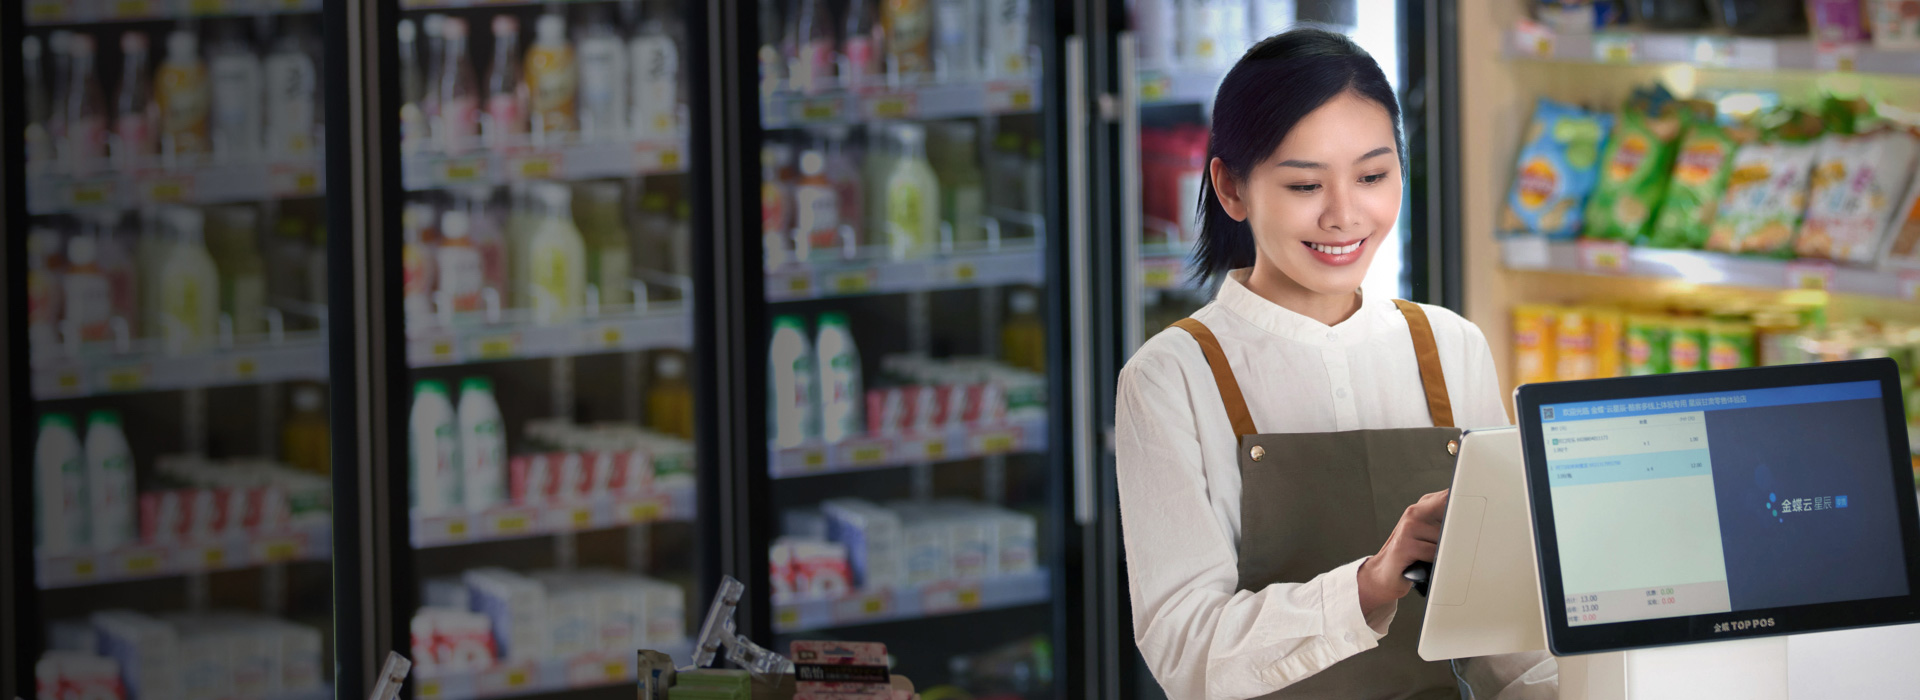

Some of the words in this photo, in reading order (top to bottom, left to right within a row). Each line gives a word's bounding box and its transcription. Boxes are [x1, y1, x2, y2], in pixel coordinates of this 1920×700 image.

[1660, 588, 1674, 596] 0.00
[1580, 594, 1598, 603] 13.00
[1661, 597, 1676, 605] 0.00
[1582, 603, 1599, 613] 13.00
[1582, 613, 1597, 621] 0.00
